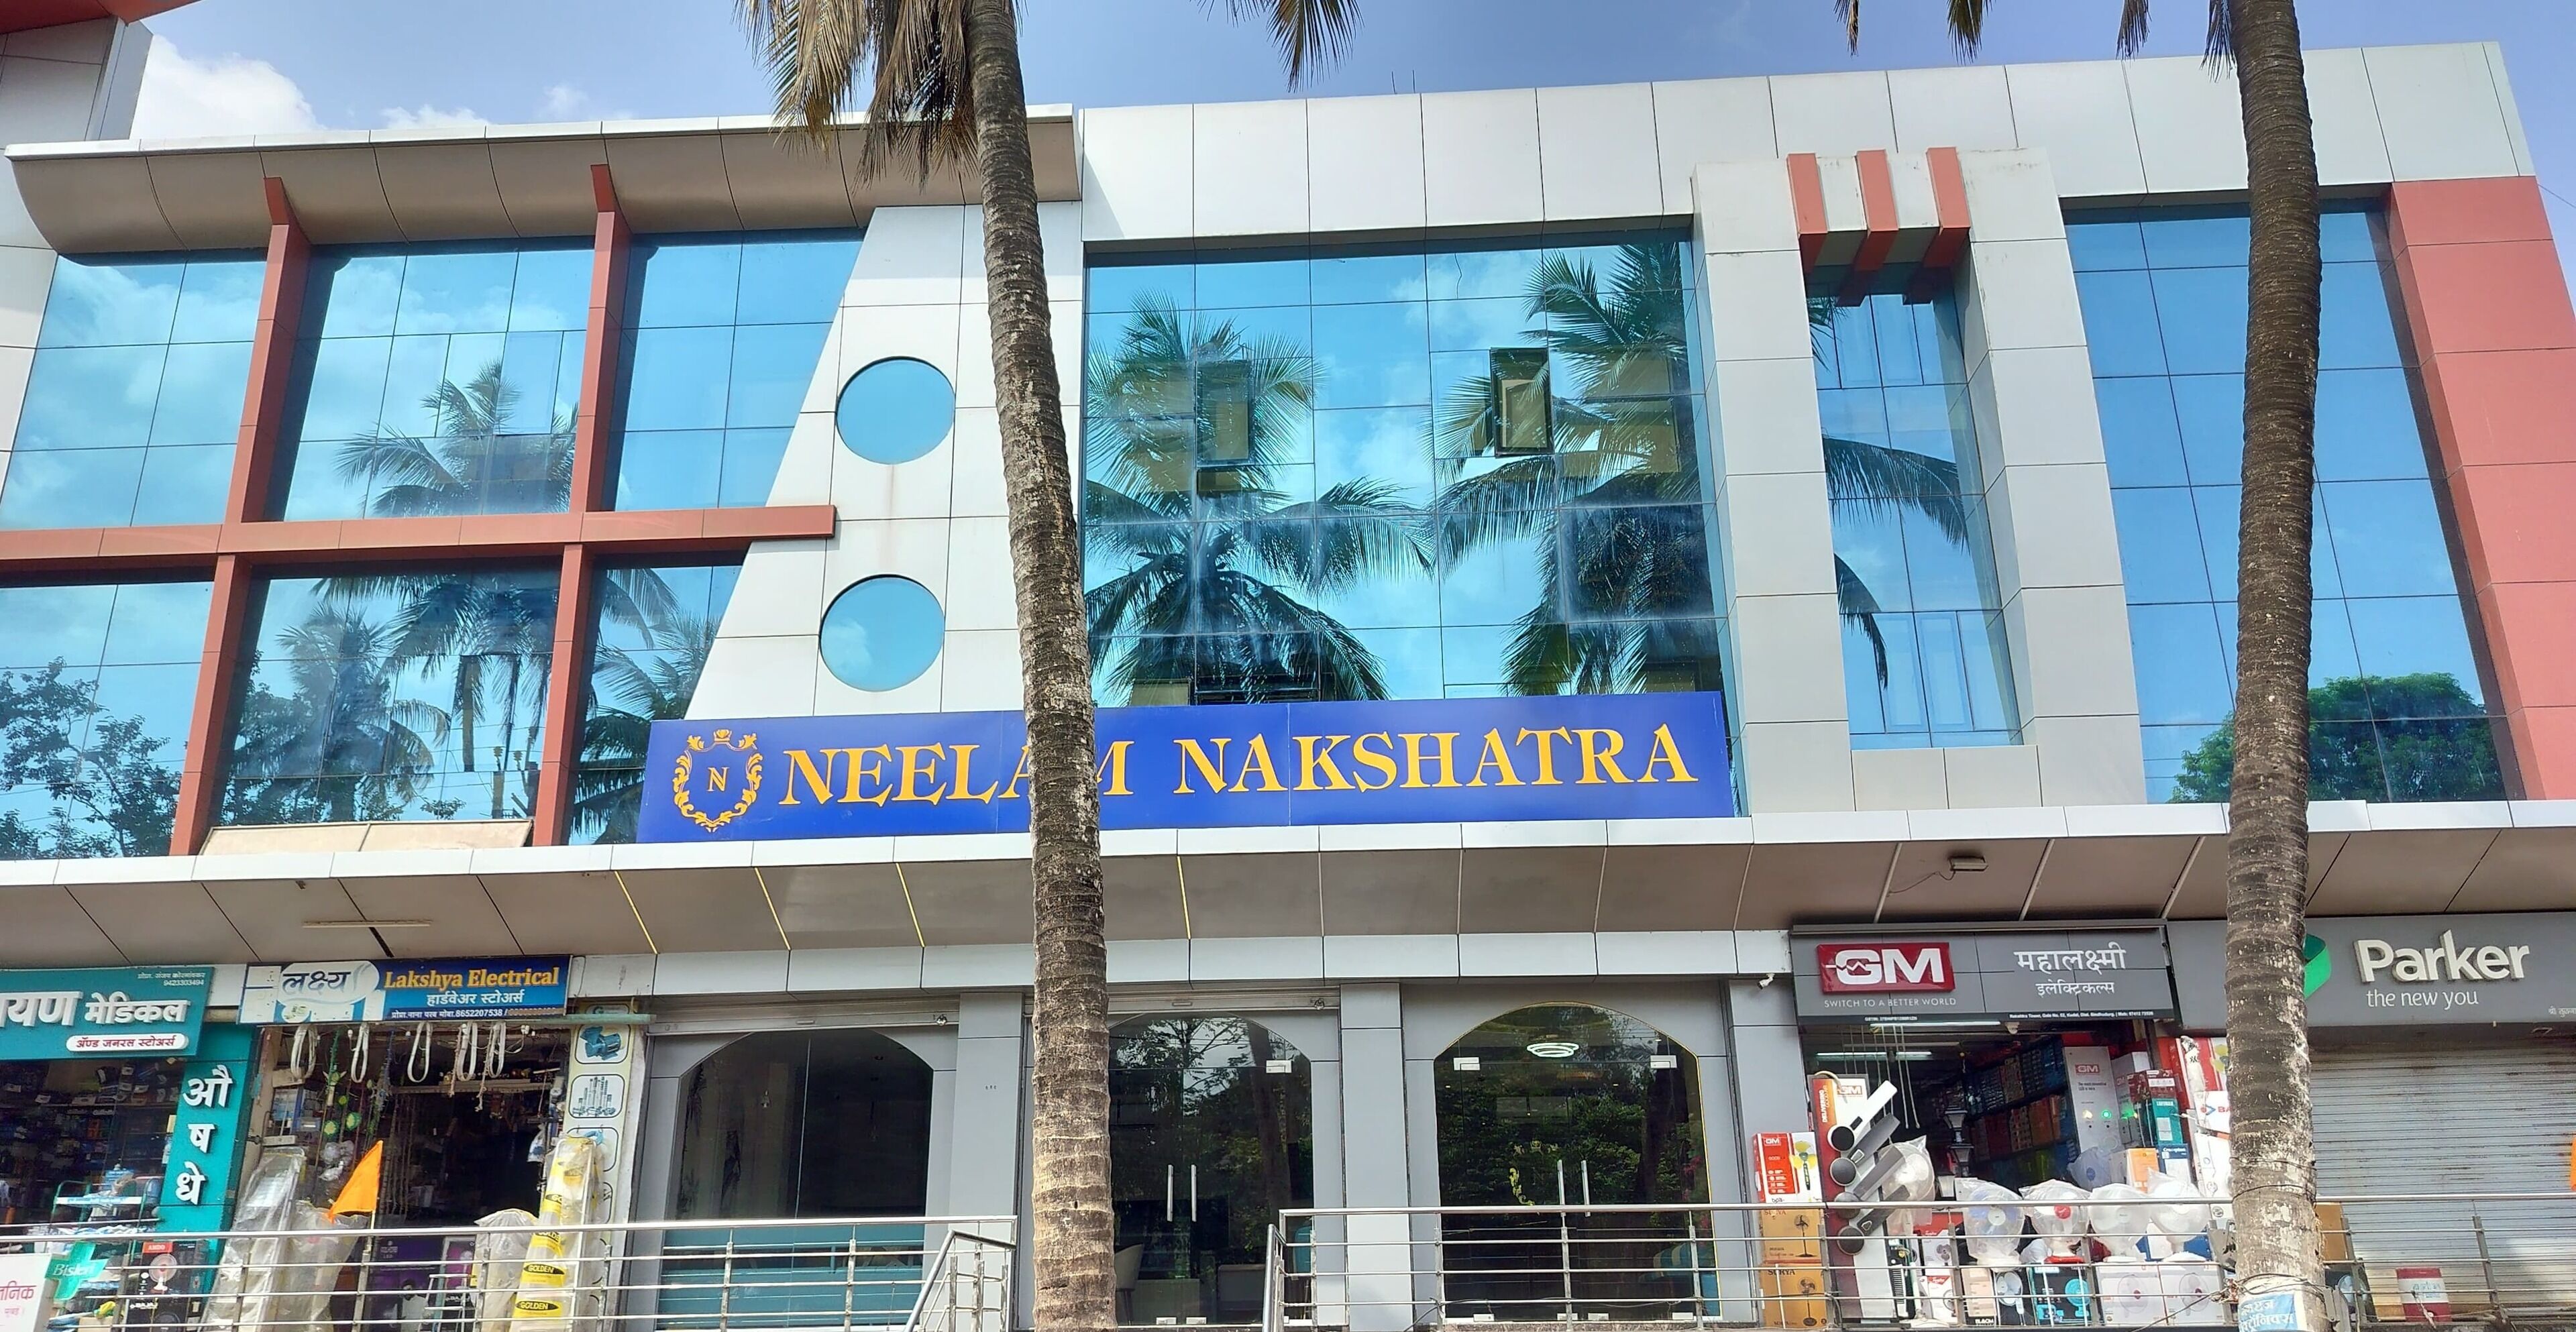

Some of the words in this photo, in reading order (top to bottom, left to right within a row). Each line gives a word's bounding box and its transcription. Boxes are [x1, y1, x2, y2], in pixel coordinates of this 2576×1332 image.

[1173, 723, 1699, 794] NAKSHATRA
[707, 767, 727, 791] N
[1825, 948, 1945, 985] GM
[2014, 942, 2127, 975] महालक्ष्मी
[2353, 930, 2530, 983] Parker
[282, 970, 351, 995] लक्ष्य
[384, 970, 463, 991] Lakshya
[468, 966, 559, 987] Electrical
[85, 991, 191, 1024] मेडिकल
[427, 991, 477, 1006] हार्डवेअर
[480, 989, 525, 1003] स्टोअर्स
[1824, 999, 1860, 1008] SWITCH
[1888, 999, 1919, 1007] BETTER
[1921, 998, 1956, 1006] WORLD
[2366, 989, 2396, 1007] the
[2401, 991, 2438, 1006] new
[2442, 990, 2479, 1010] you
[103, 1039, 136, 1047] जनरल
[138, 1035, 176, 1047] स्टोअर्स
[1819, 1089, 1828, 1123] DELIVERING
[528, 1264, 555, 1273] GOLDEN
[520, 1301, 549, 1310] GOLDEN
